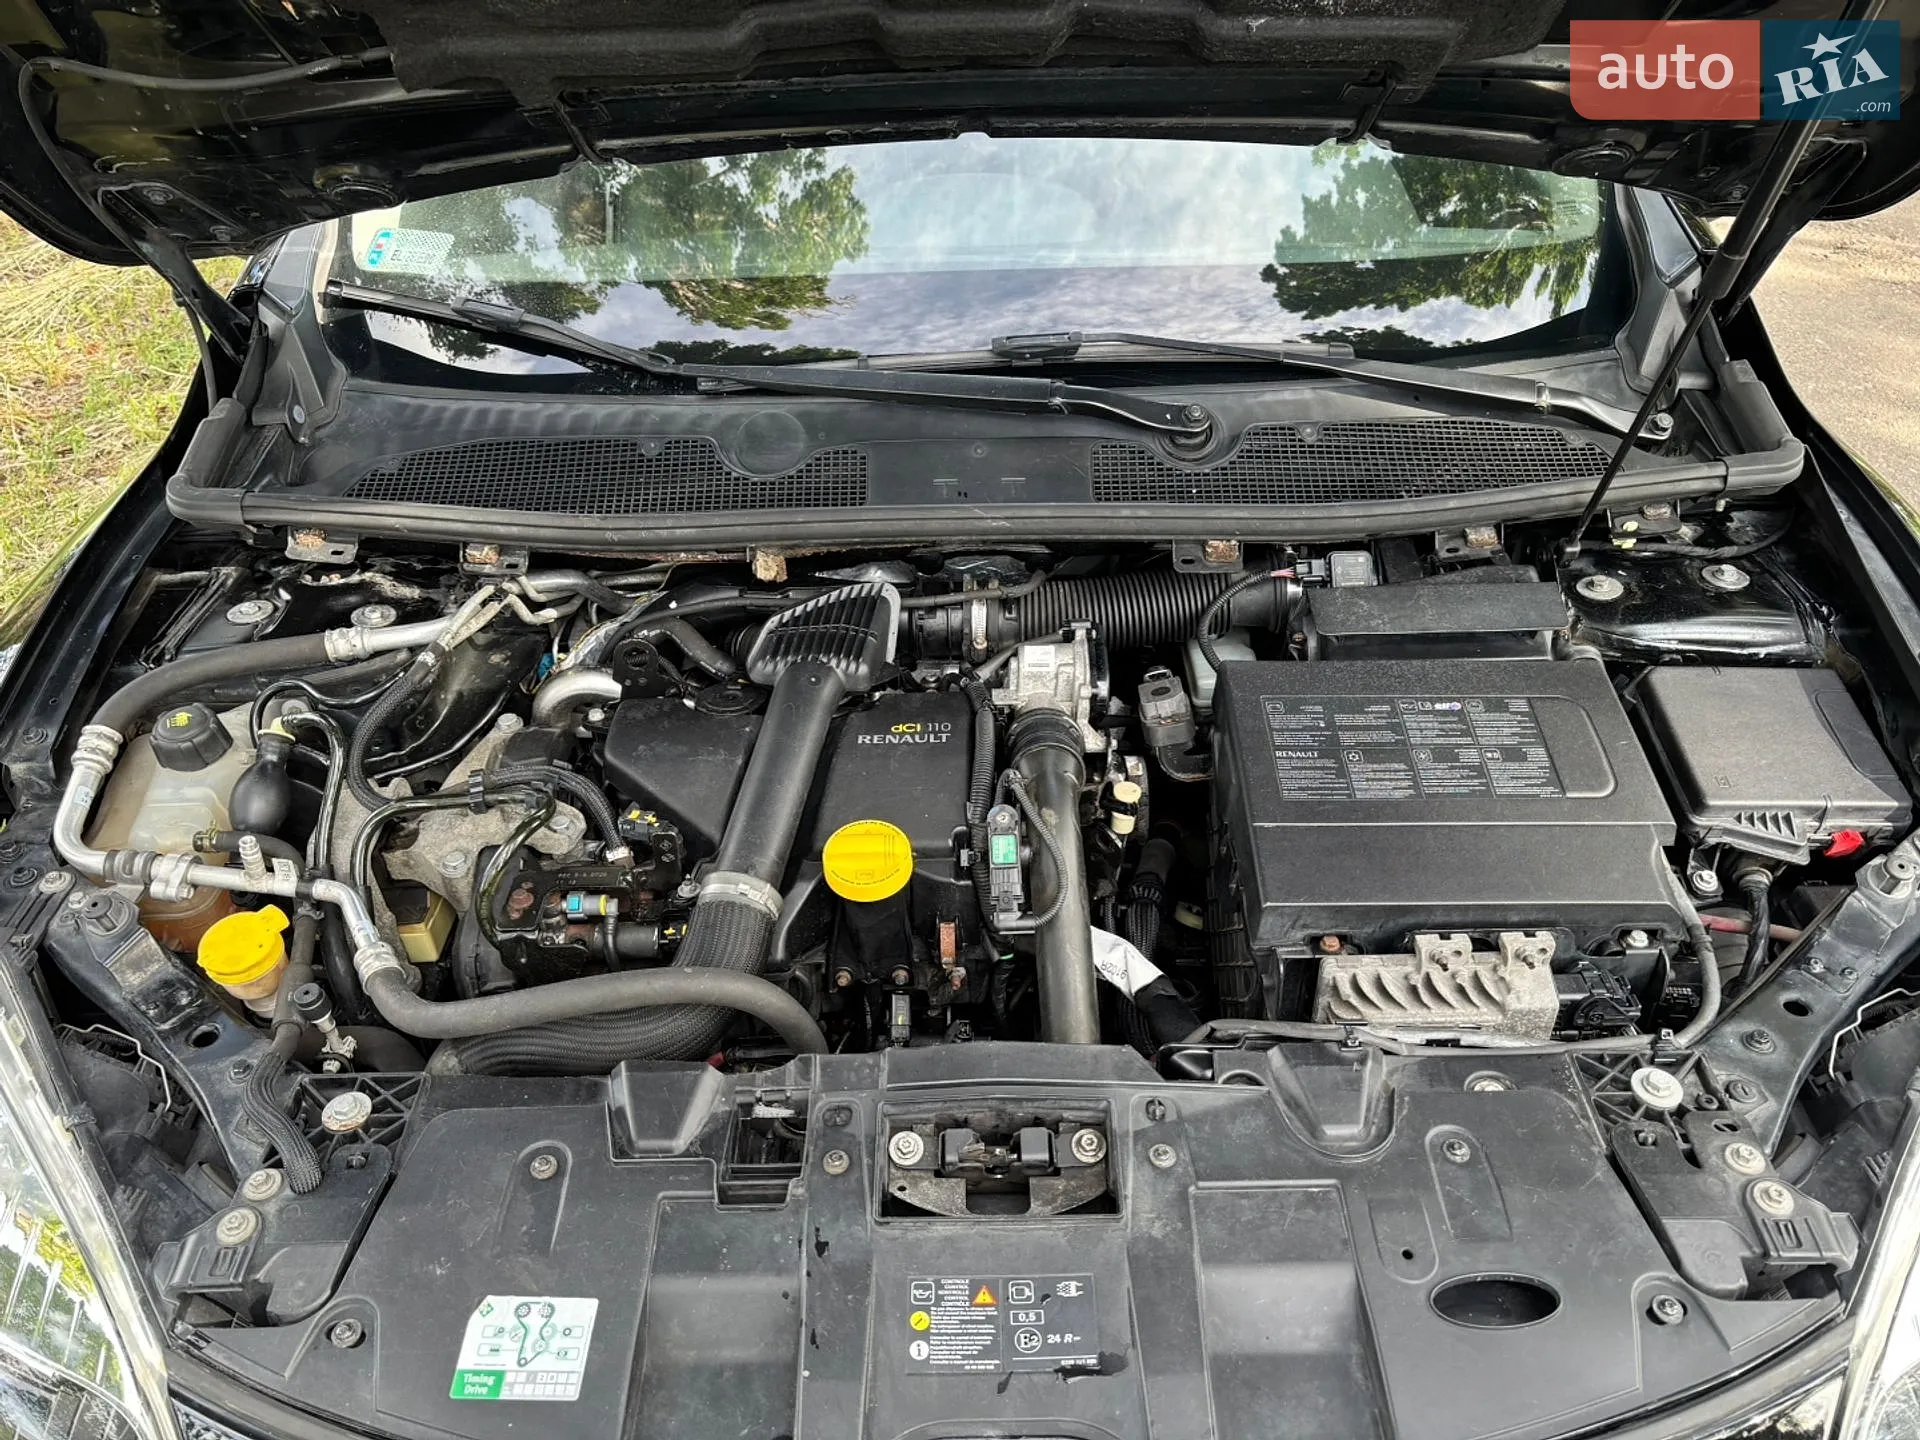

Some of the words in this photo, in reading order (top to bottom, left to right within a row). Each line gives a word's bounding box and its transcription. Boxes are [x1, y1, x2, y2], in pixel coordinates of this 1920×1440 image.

[927, 722, 951, 732] 110
[857, 733, 951, 744] RENAULT
[1274, 750, 1319, 758] RENAULT
[1018, 1312, 1036, 1322] 0,5
[1019, 1333, 1039, 1348] E2
[1046, 1333, 1061, 1344] 24
[463, 1373, 495, 1386] Timing
[464, 1384, 489, 1395] Drive
